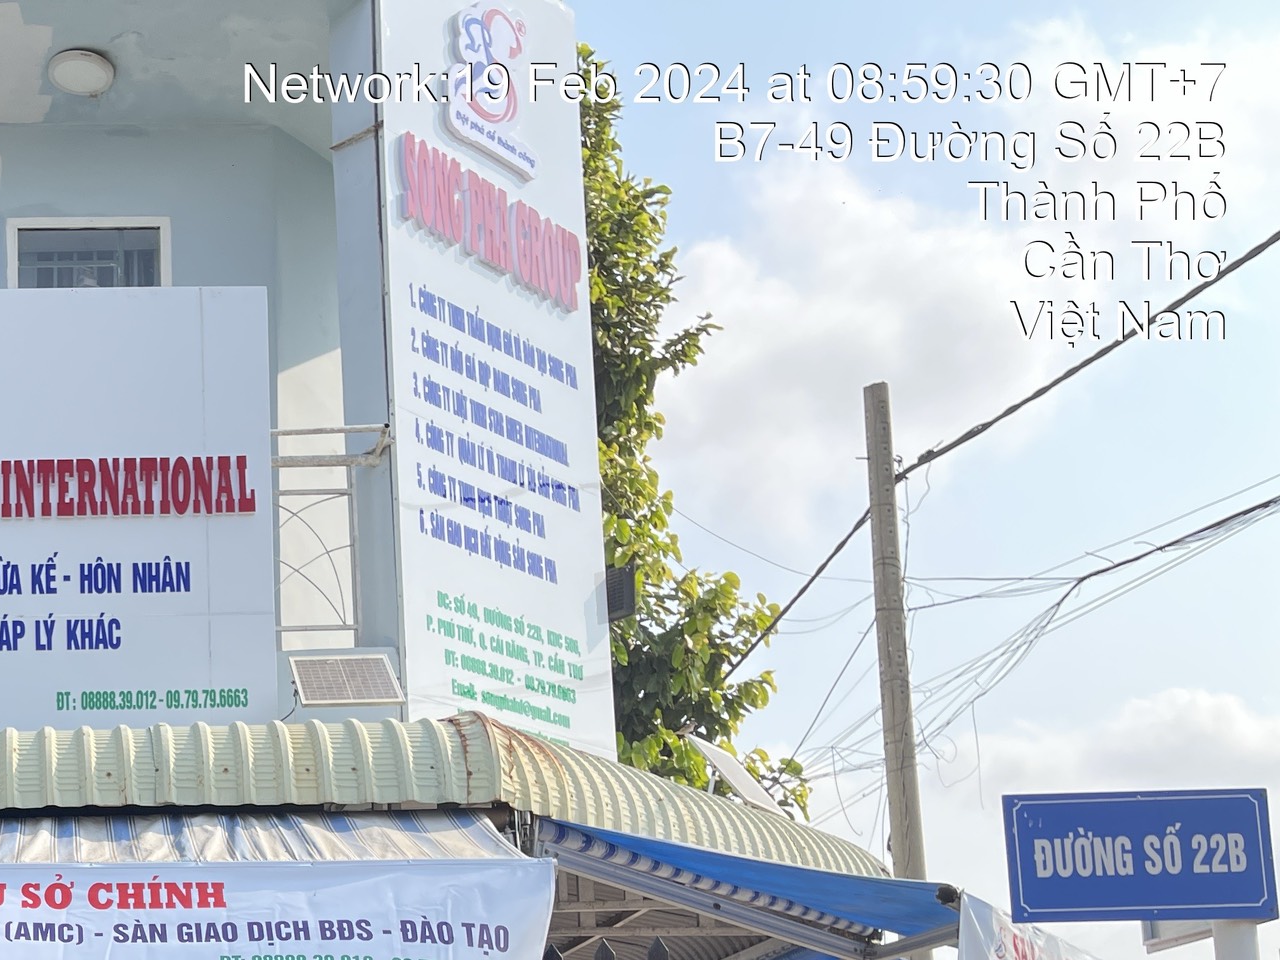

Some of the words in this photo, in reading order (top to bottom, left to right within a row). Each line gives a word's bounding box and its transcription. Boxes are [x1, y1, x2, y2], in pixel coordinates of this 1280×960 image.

[403, 130, 465, 246] SONG
[467, 168, 514, 274] PHA
[515, 199, 582, 313] GROUP
[1, 456, 256, 517] INTERNATIONAL
[30, 551, 58, 595] KẾ
[79, 556, 122, 595] HÔN
[132, 555, 191, 594] NHÂN
[34, 612, 56, 652] LÝ
[66, 613, 122, 651] KHÁC
[56, 691, 75, 711] ĐT:
[80, 690, 157, 710] 08888.39.012
[165, 687, 249, 709] 09.79.79.6663
[1033, 826, 1135, 879] ĐƯỜNG
[1143, 822, 1183, 876] SỐ
[1191, 832, 1248, 875] 22B
[20, 873, 74, 911] SỞ
[87, 874, 228, 911] CHÍNH
[4, 919, 85, 946] (AMC)
[112, 917, 169, 945] SÀN
[176, 921, 239, 944] GIAO
[246, 920, 312, 947] DỊCH
[319, 918, 375, 943] BĐS
[398, 914, 456, 946] ĐÀO
[460, 921, 510, 957] TẠO
